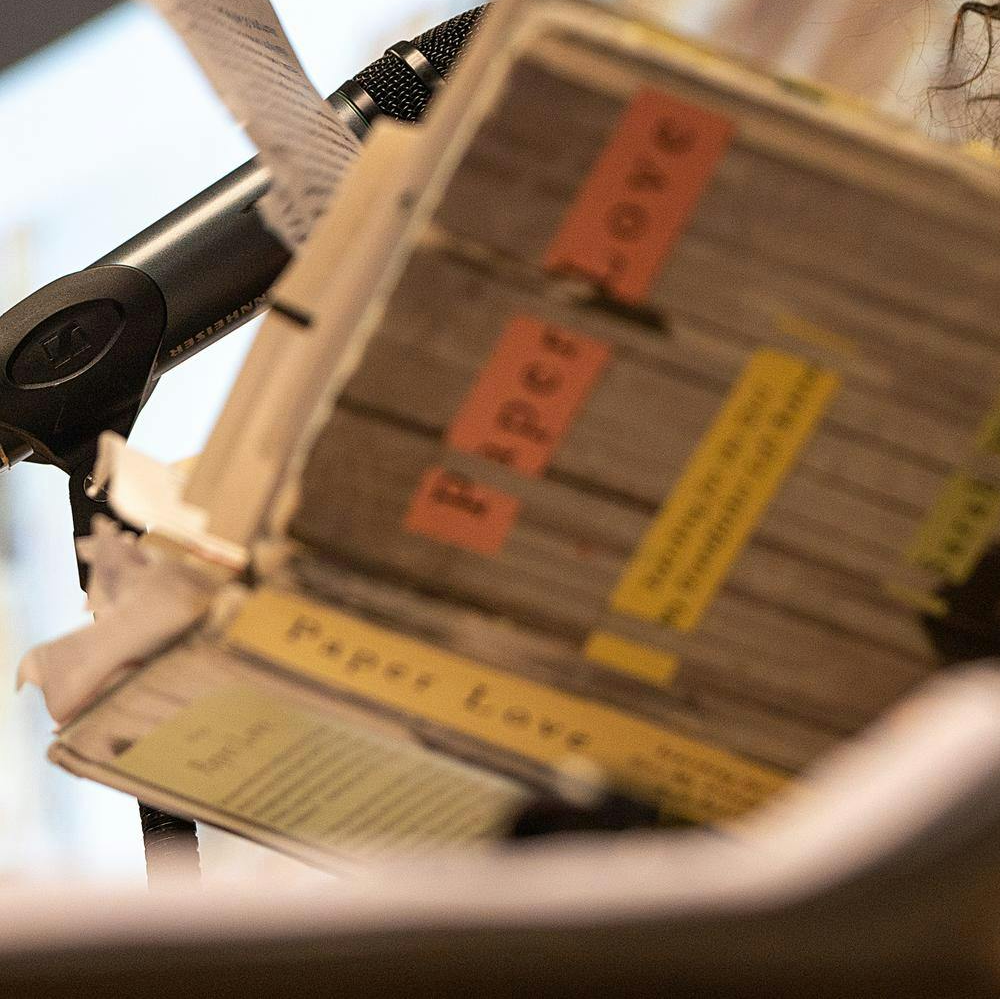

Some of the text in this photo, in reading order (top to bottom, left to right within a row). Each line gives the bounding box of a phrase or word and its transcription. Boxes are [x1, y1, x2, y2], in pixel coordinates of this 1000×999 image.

[168, 292, 268, 358] NNHEISER
[284, 615, 592, 751] Paper Love
